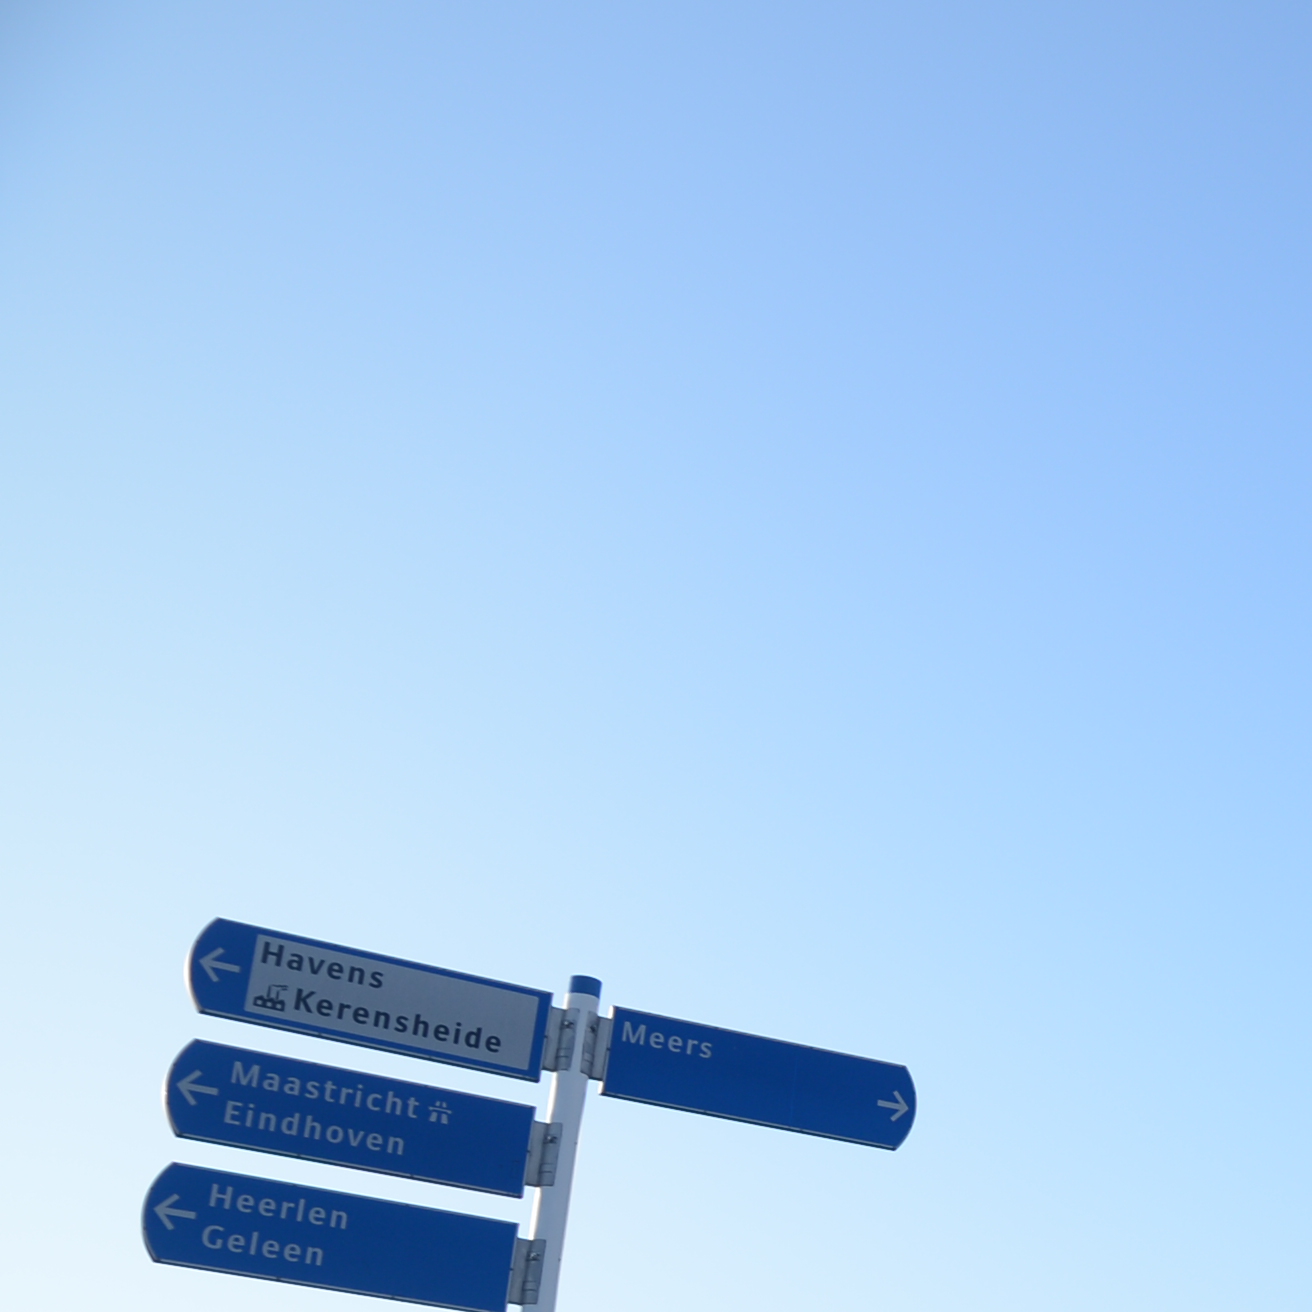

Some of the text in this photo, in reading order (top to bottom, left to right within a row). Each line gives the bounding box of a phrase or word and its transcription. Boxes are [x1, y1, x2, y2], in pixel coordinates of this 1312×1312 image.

[260, 940, 385, 990] Havens
[291, 986, 503, 1055] Kerensheide
[621, 1021, 714, 1060] Meers
[230, 1060, 420, 1121] Maastricht
[222, 1100, 406, 1156] Eindhoven
[208, 1183, 350, 1231] Heerlen
[201, 1225, 324, 1267] Geleen
